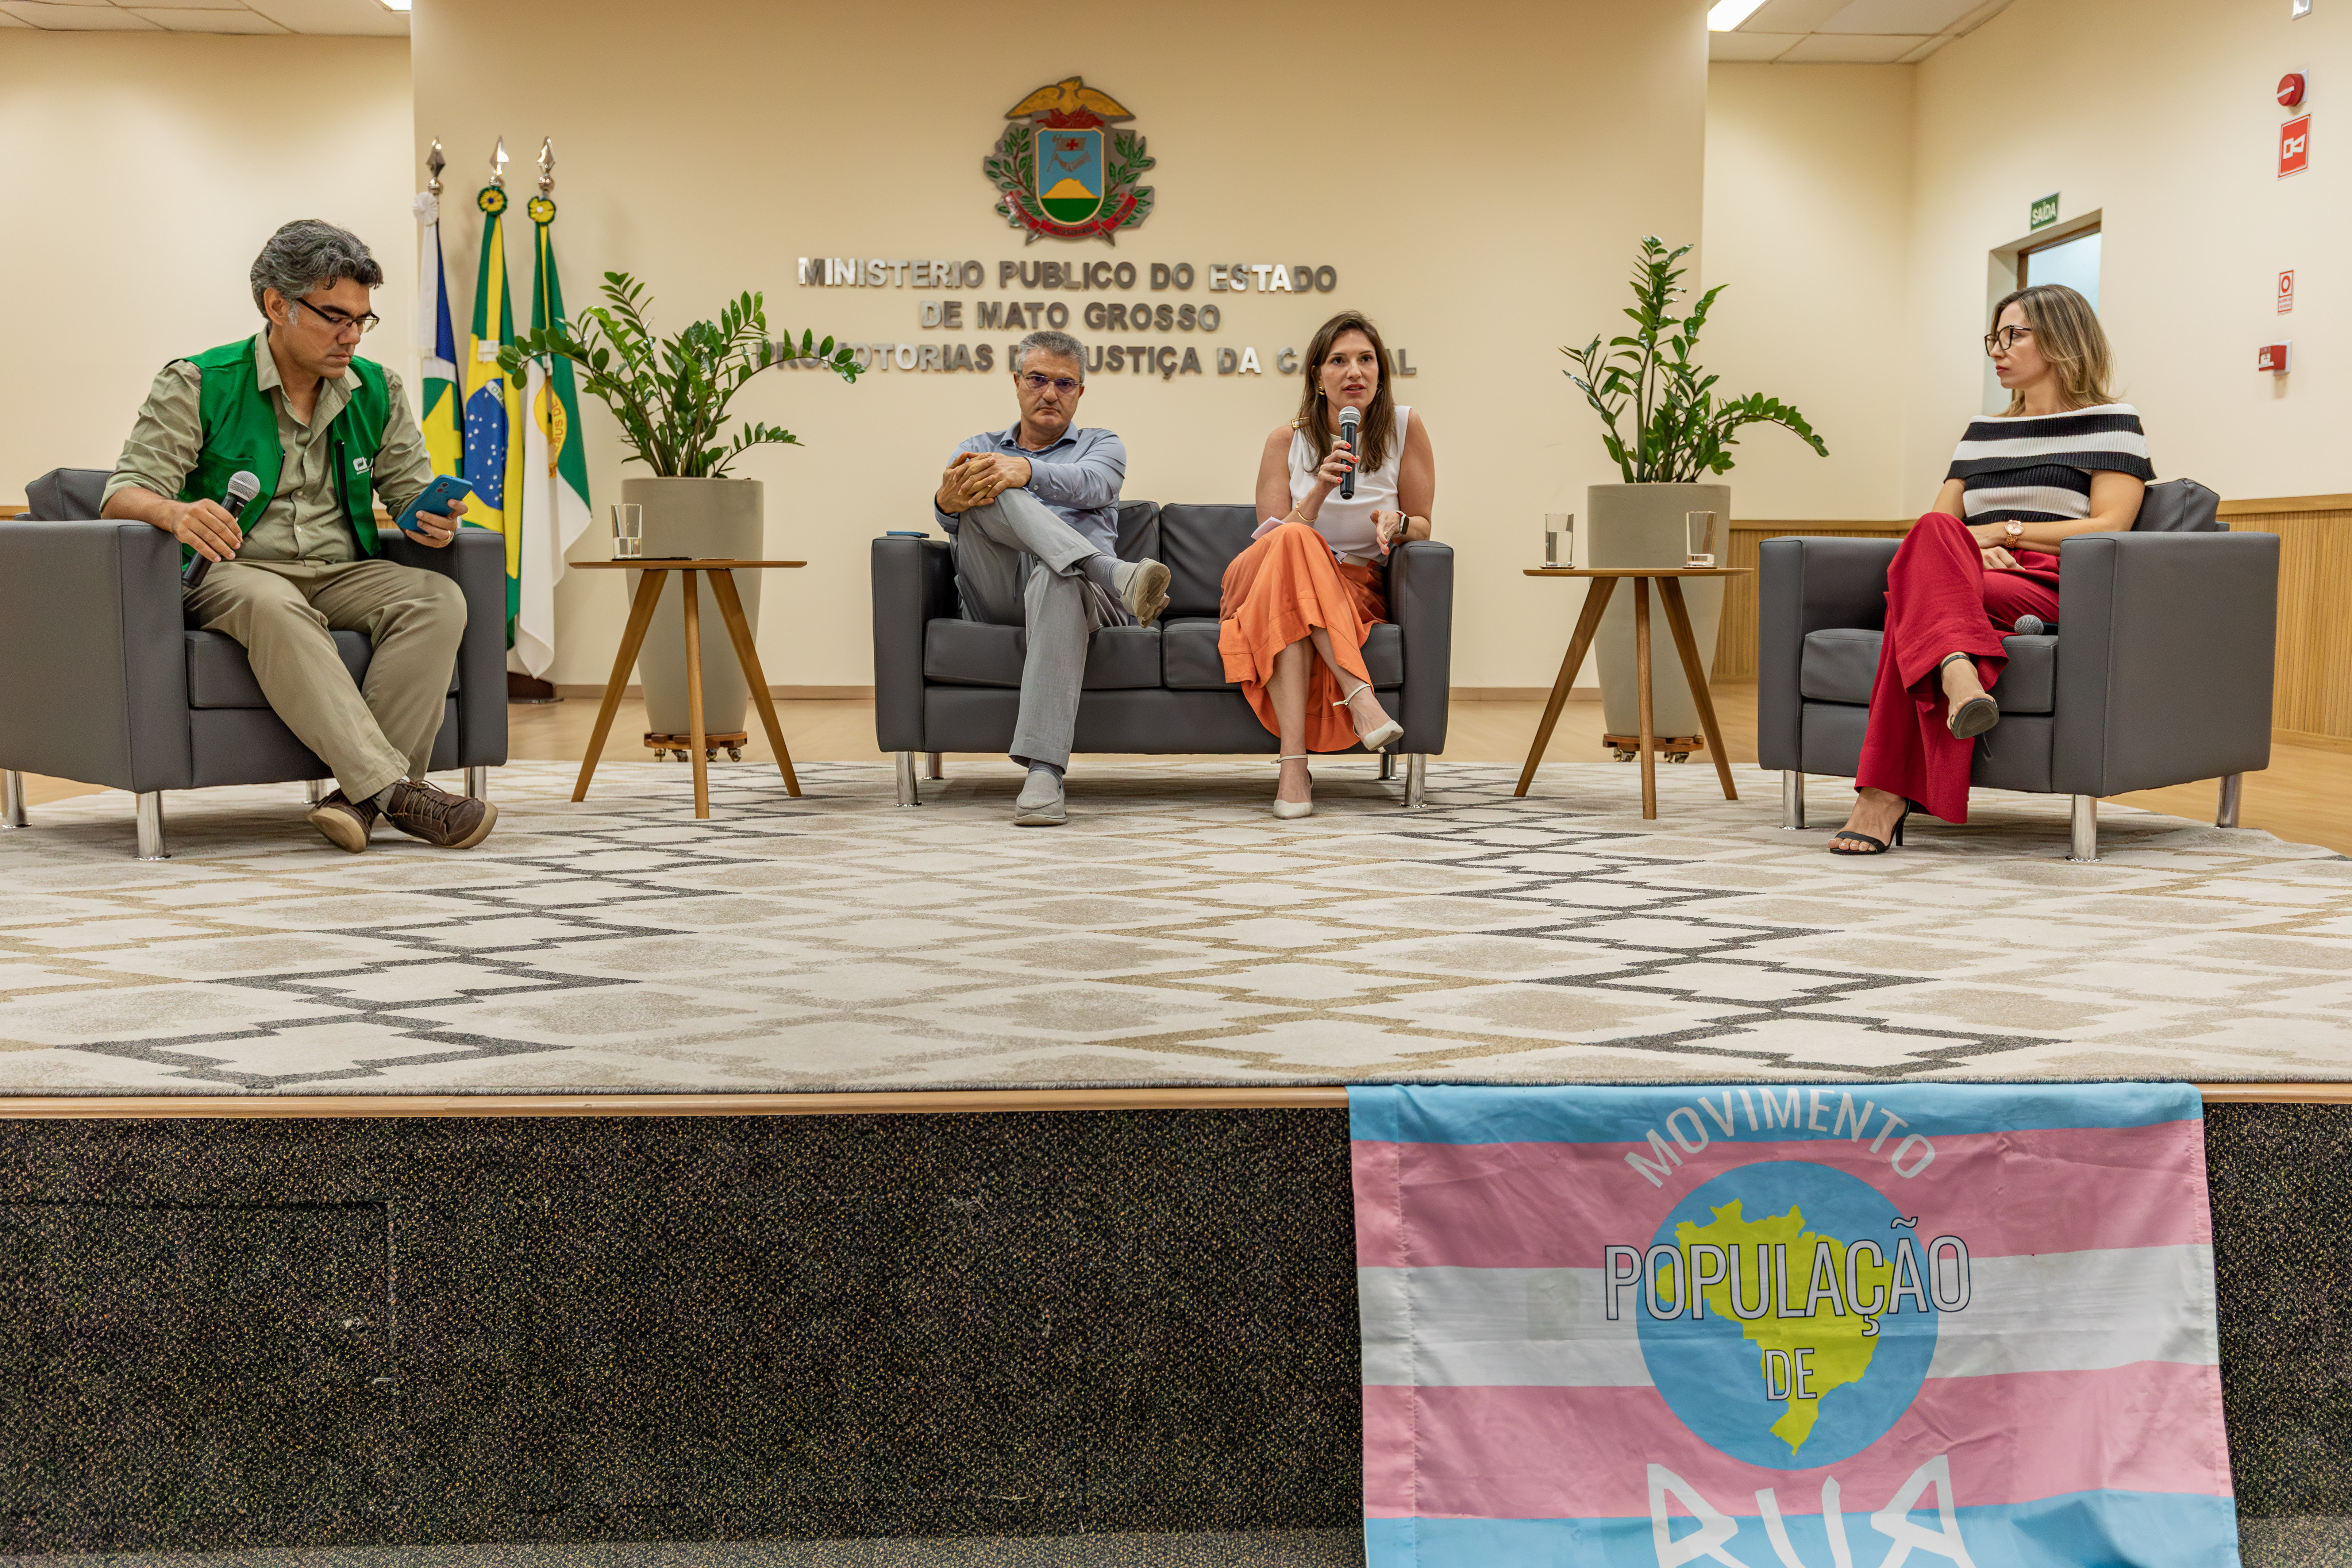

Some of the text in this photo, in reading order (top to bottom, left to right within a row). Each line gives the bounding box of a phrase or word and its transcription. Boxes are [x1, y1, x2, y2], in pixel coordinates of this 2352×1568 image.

[2032, 201, 2056, 225] SAÍDA
[798, 257, 1337, 292] MINISTERIO PUBLICO DO ESTADO
[921, 301, 1220, 331] DE MATO GROSSO
[1086, 345, 1202, 380] USTIÇA
[1217, 347, 1262, 374] DA
[1624, 1087, 1936, 1188] MOVIMENTO
[1605, 1216, 1971, 1336] POPULAÇÃO
[1765, 1348, 1817, 1401] DE
[1647, 1455, 1976, 1568] RUA
